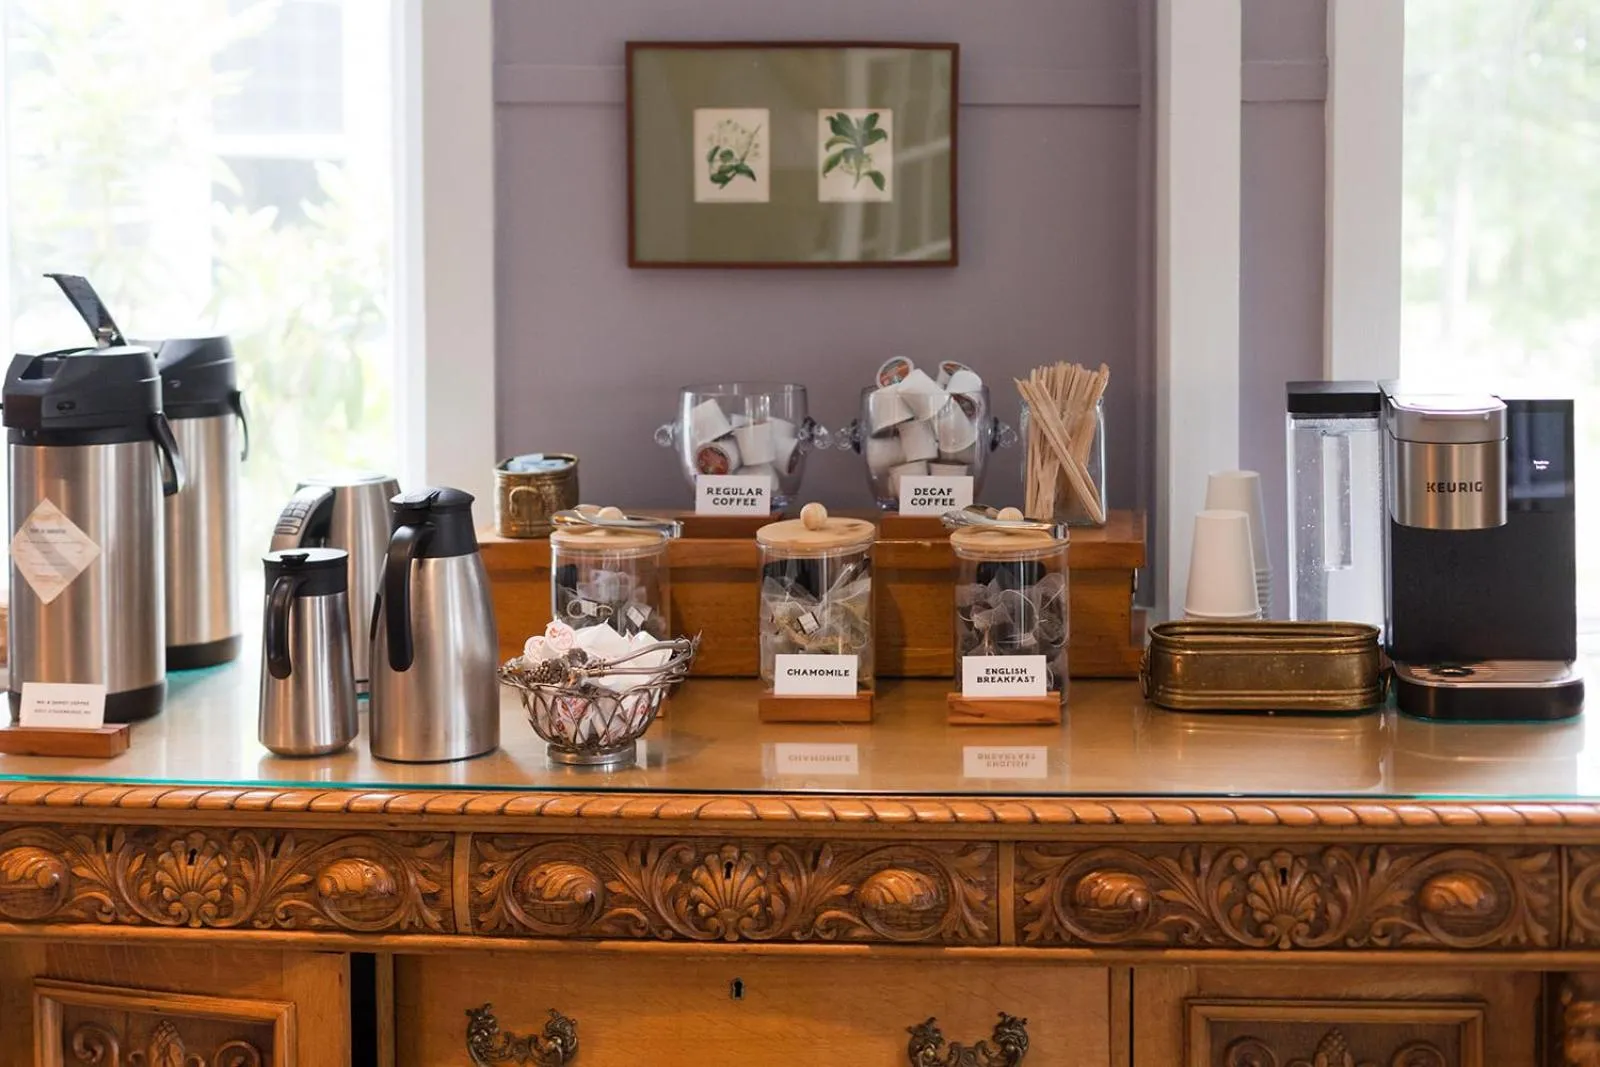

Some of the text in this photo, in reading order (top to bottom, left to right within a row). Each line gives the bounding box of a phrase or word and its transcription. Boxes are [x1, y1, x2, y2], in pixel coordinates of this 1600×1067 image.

[706, 487, 763, 496] REGULAR
[914, 487, 953, 496] DECAF
[1426, 481, 1483, 493] KEURIG
[712, 497, 757, 506] COFFEE
[910, 497, 956, 506] COFFEE
[786, 668, 850, 677] CHAMOMILE
[985, 667, 1027, 675] ENGLISH
[976, 675, 1035, 684] BREAKFAST
